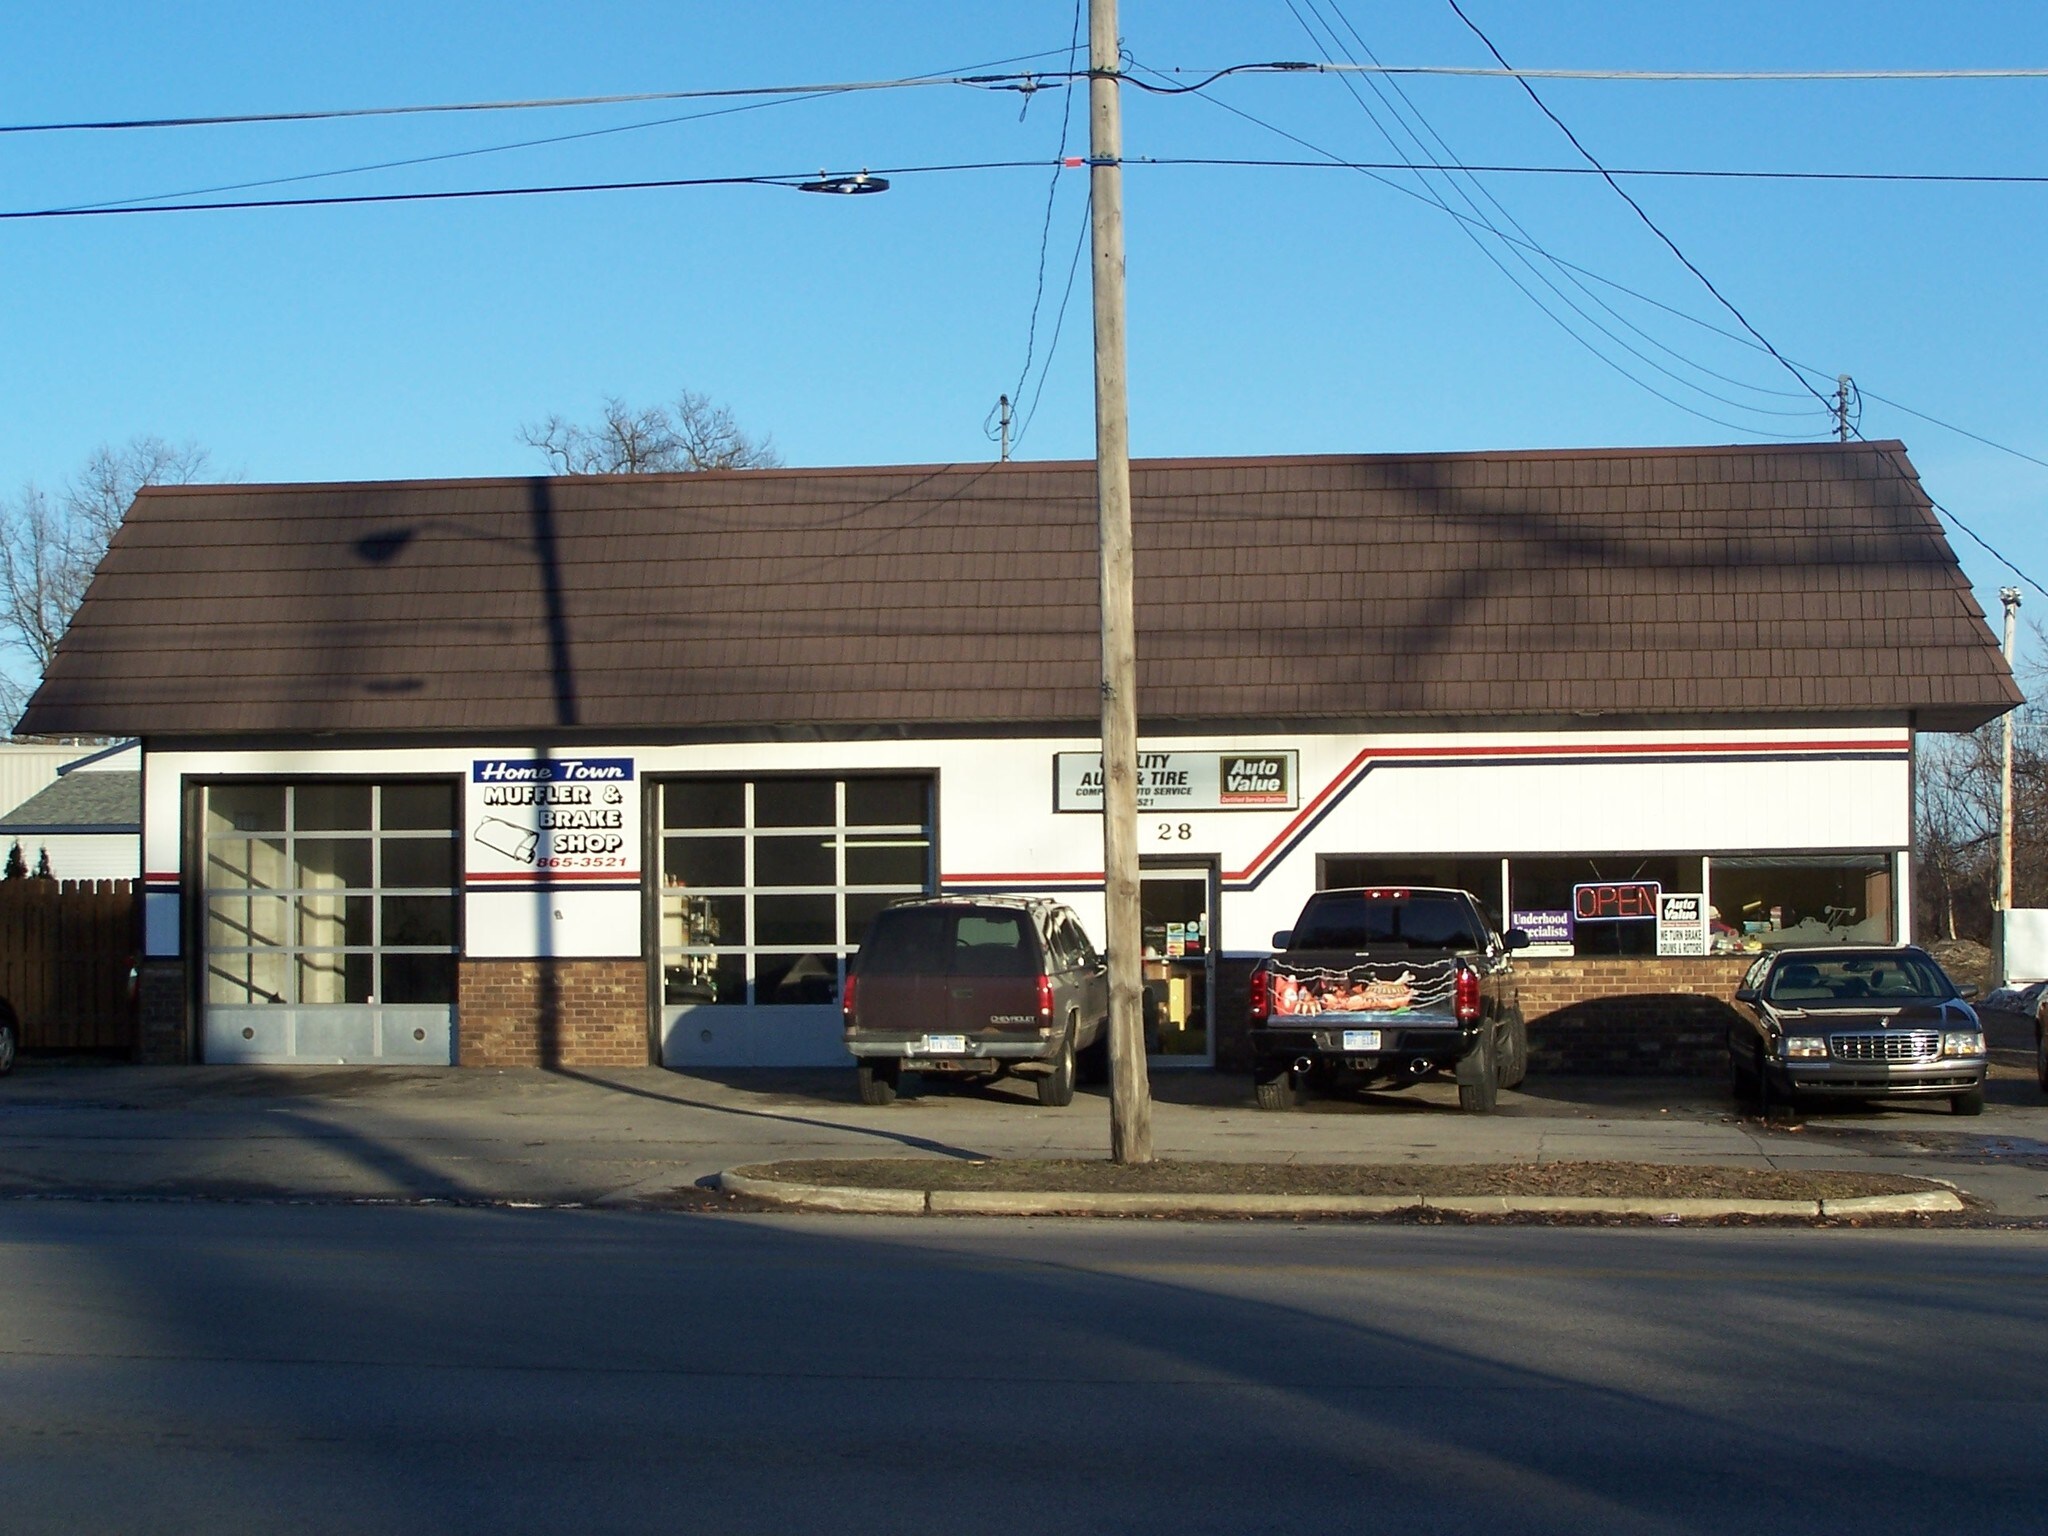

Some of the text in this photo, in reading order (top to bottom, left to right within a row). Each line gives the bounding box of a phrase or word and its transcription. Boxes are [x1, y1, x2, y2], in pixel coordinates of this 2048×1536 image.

[481, 761, 625, 781] Home Town
[1230, 758, 1278, 775] Auto
[1151, 771, 1189, 785] TIRE
[1227, 775, 1280, 792] Value
[484, 785, 623, 805] MUFFLER &
[1153, 787, 1192, 796] SERVICE
[539, 810, 622, 829] BRAKE
[554, 834, 623, 854] SHOP
[536, 857, 627, 867] 865-3521
[1577, 886, 1657, 916] OPEN
[1666, 898, 1697, 910] Auto
[1513, 912, 1568, 925] Underhood
[1664, 909, 1698, 920] Value
[1516, 925, 1568, 938] ecialists
[990, 1015, 1037, 1024] CHEVROLET
